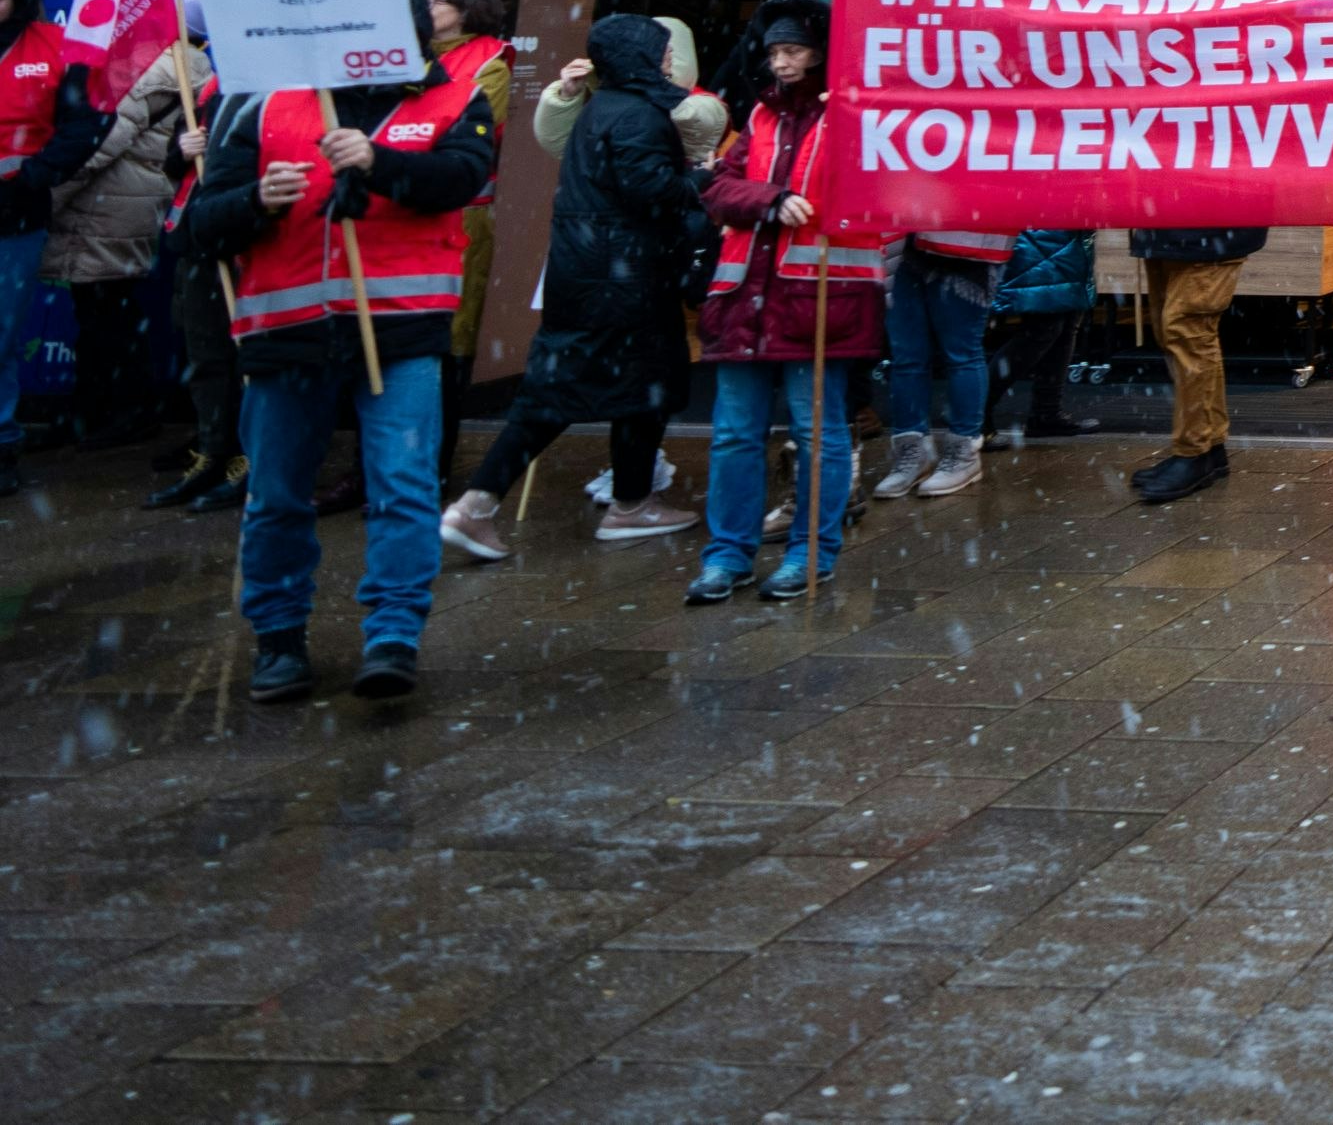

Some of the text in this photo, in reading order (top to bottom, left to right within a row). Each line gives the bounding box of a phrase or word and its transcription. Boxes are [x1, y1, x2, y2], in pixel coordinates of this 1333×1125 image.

[245, 21, 377, 38] #WirBrauchenMehr
[864, 13, 1014, 89] FÜR
[14, 62, 49, 78] gpa
[343, 47, 408, 79] gpa
[387, 122, 436, 143] gpa
